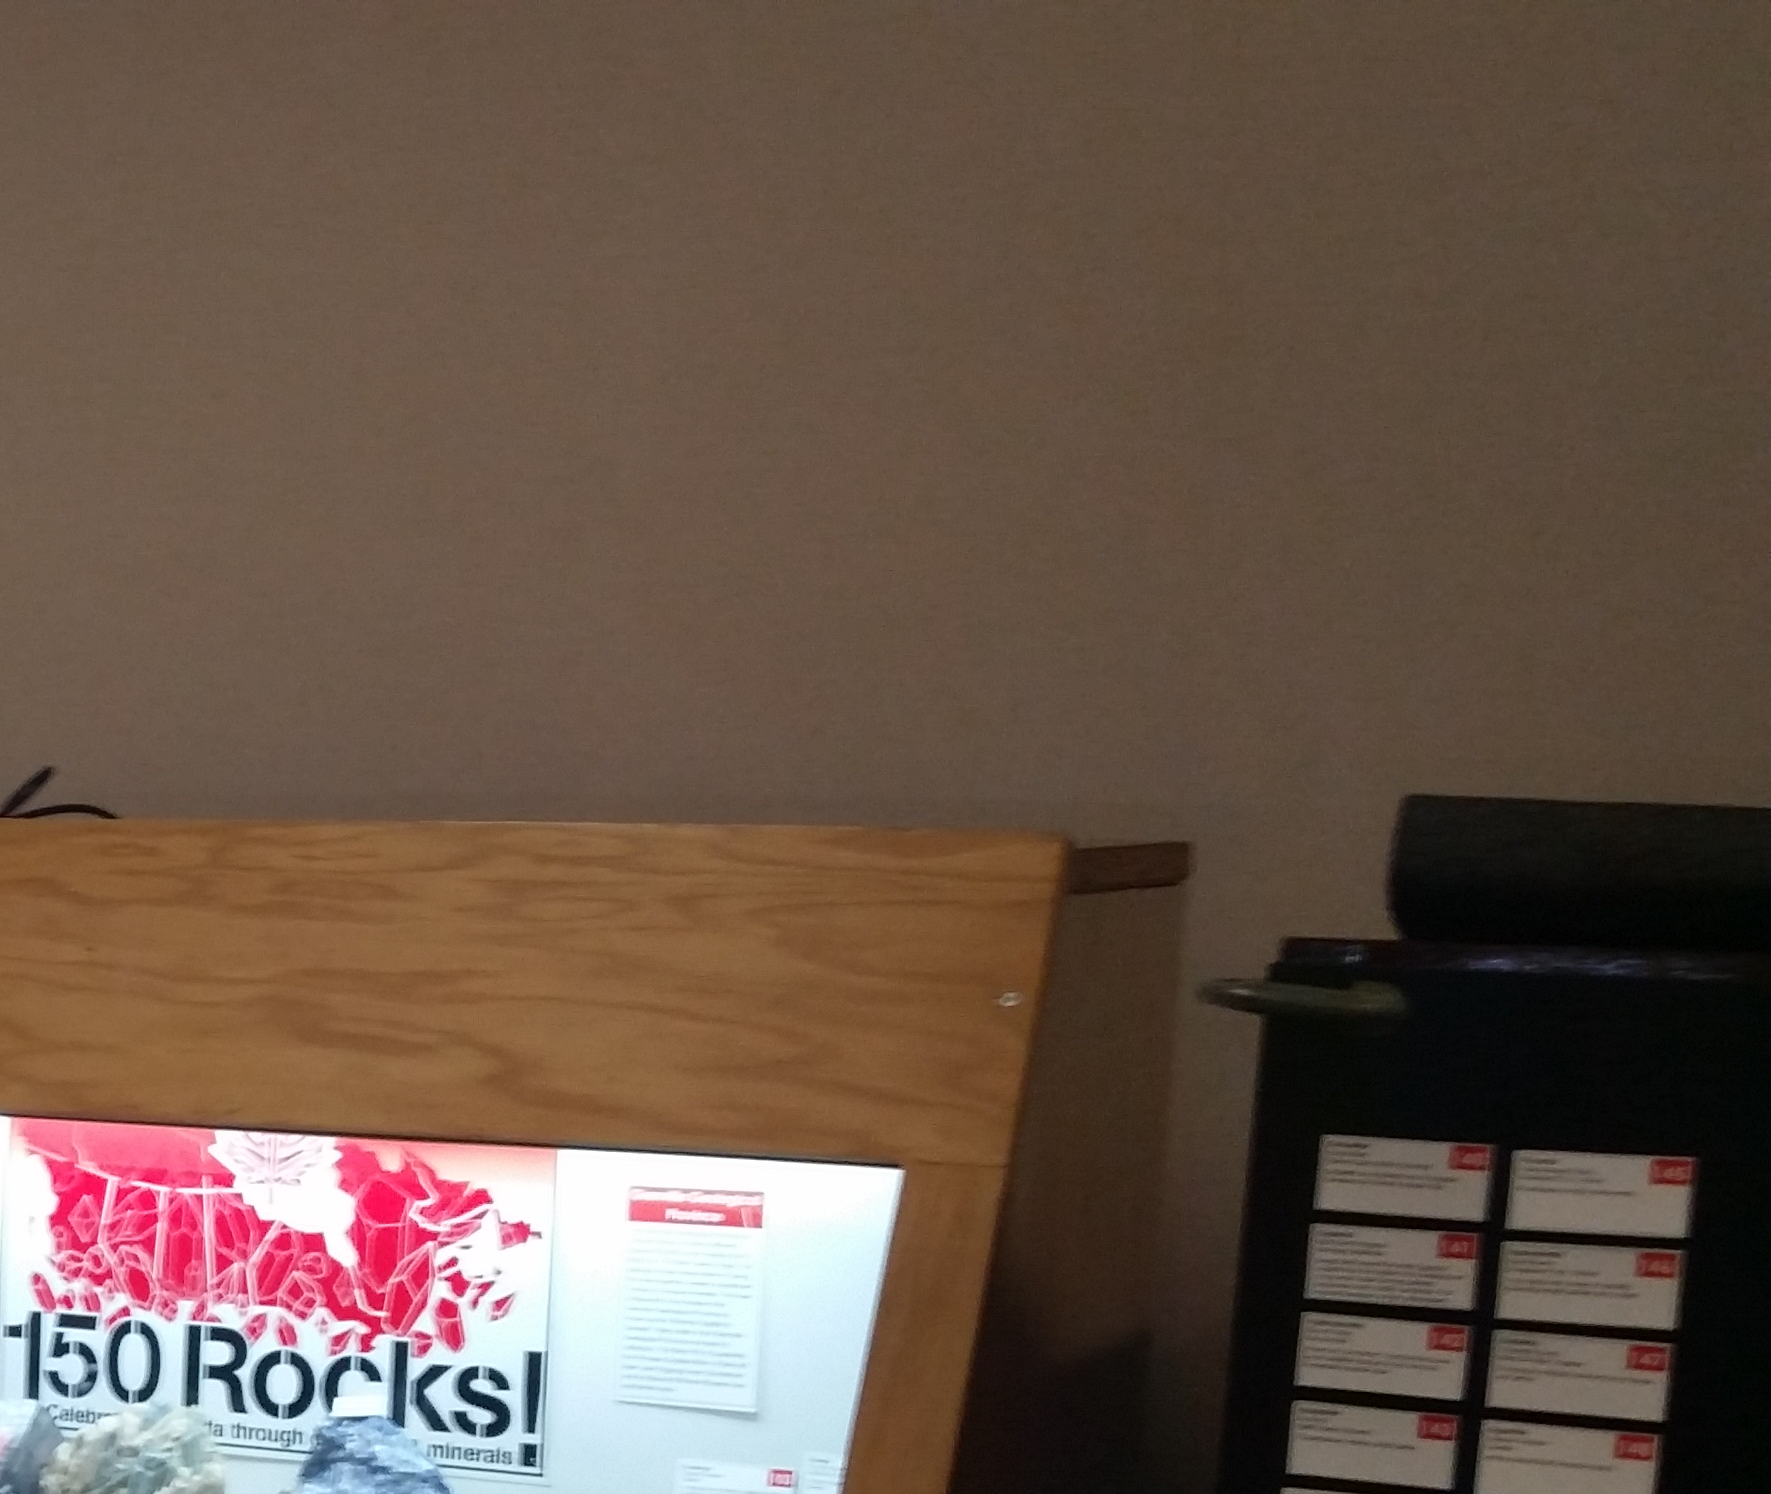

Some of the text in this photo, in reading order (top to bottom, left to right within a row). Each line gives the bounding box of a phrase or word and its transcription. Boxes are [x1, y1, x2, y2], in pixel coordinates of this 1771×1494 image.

[3, 1311, 546, 1466] 150 Rocks!
[231, 1421, 303, 1448] through
[427, 1443, 513, 1466] minerals
